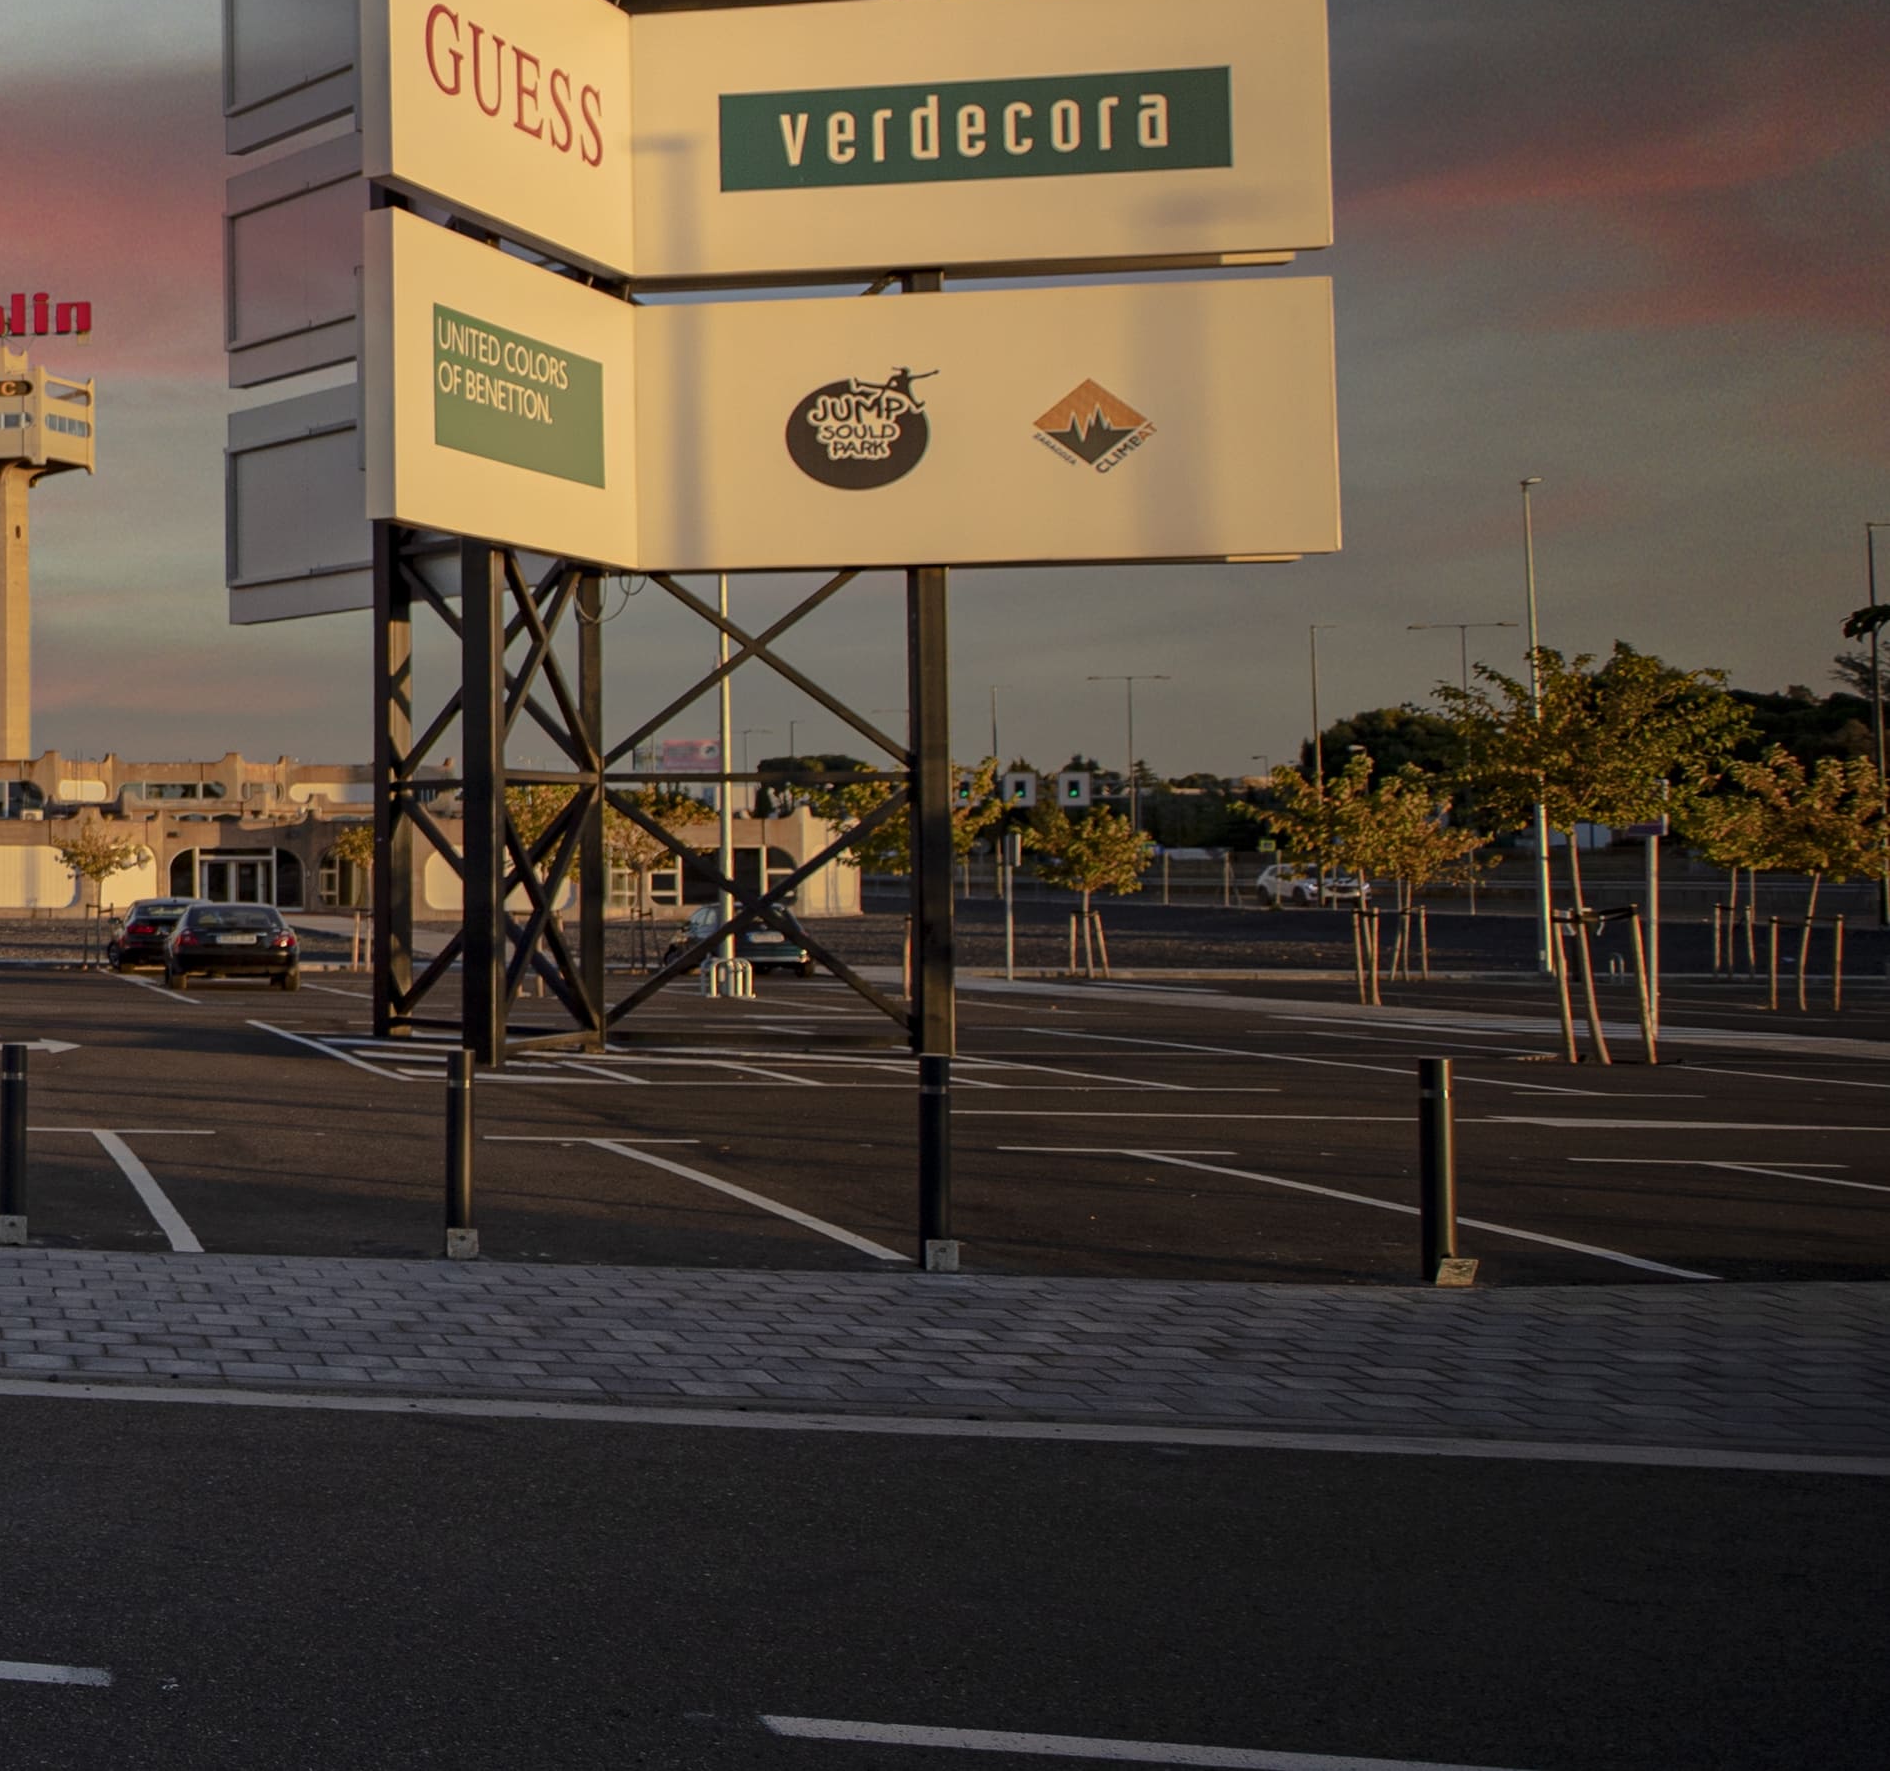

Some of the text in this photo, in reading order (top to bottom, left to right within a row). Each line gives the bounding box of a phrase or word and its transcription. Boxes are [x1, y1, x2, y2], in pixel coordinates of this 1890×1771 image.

[425, 3, 603, 168] GUESS
[779, 93, 1168, 166] verdecora
[438, 316, 569, 390] UNITED COLORS
[438, 360, 554, 424] OF BENETTON.
[812, 396, 905, 423] JUMP
[822, 424, 896, 440] SOULD
[833, 441, 887, 456] PARK
